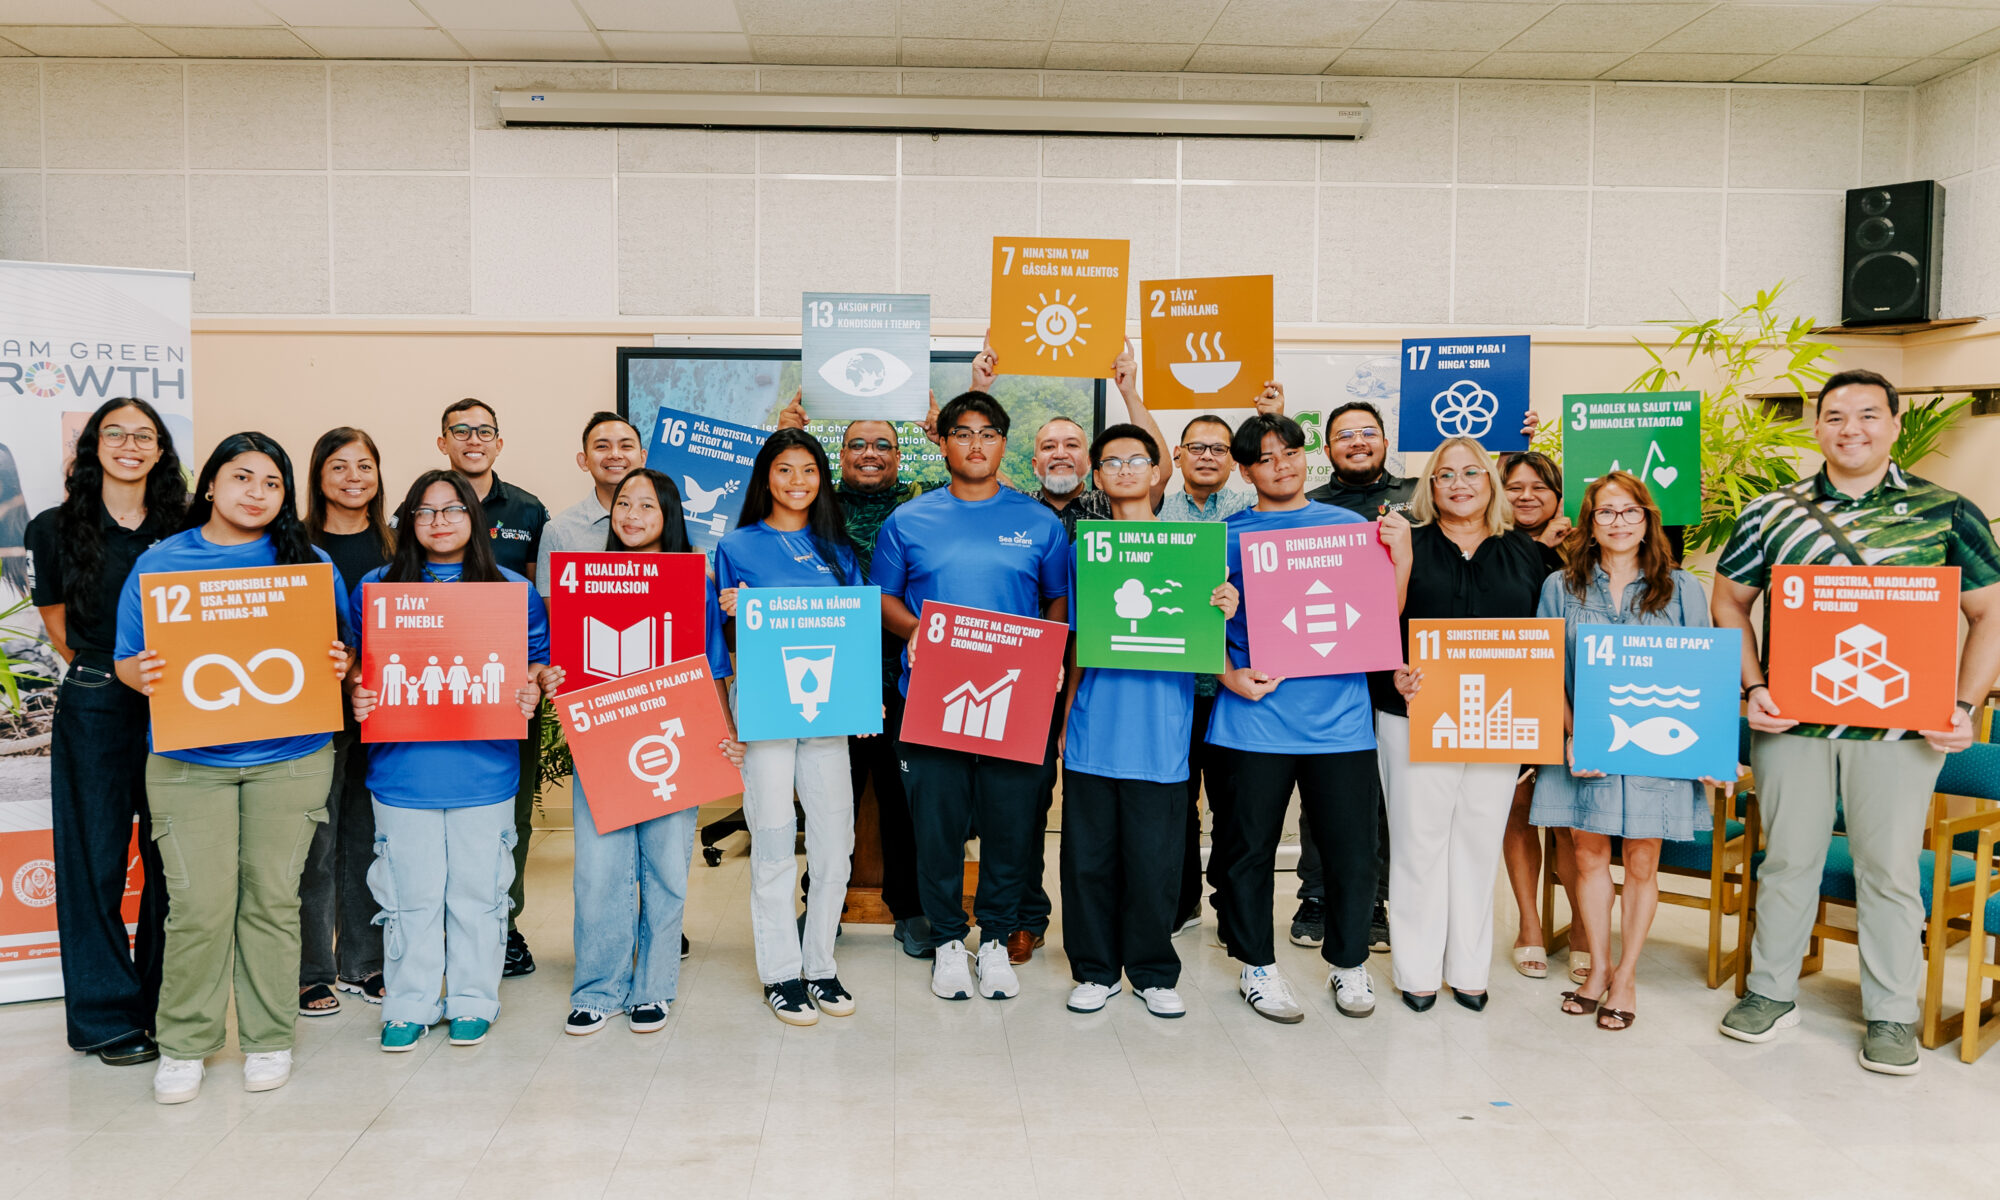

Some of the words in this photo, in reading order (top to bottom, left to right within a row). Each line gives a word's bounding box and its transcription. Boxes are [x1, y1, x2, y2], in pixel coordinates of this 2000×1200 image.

[1002, 247, 1015, 275] 7
[1023, 248, 1068, 259] NINA'SINA
[1071, 249, 1089, 259] YAN
[1022, 262, 1058, 275] GÅSGÅS
[1061, 266, 1073, 276] NA
[1076, 267, 1119, 277] ALIENTOS
[1170, 288, 1197, 301] TÅYA'
[838, 303, 868, 312] AKSION
[871, 304, 886, 312] PUT
[889, 304, 892, 312] I
[1150, 290, 1165, 317] 2
[1171, 303, 1218, 316] NIÑALANG
[808, 301, 834, 328] 13
[838, 319, 882, 328] KONDISION
[885, 320, 888, 328] I
[891, 320, 920, 328] TIEMPO
[4, 340, 50, 357] AM
[71, 342, 183, 362] GREEN
[1439, 345, 1474, 354] INETNON
[1477, 345, 1499, 354] PARA
[1502, 344, 1505, 353] I
[1407, 346, 1431, 370] 17
[1438, 360, 1467, 369] HINGA'
[1470, 360, 1490, 368] SIHA
[0, 362, 184, 399] ROWTH
[1590, 404, 1625, 414] MAOLEK
[1628, 403, 1640, 413] NA
[1643, 402, 1671, 412] SALUT
[1673, 401, 1691, 411] YAN
[1571, 403, 1587, 431] 3
[1590, 419, 1634, 429] MINAOLEK
[1637, 417, 1683, 427] TATAOTAO
[661, 418, 687, 447] 16
[712, 426, 753, 444] HUSTISTIA,
[755, 436, 768, 446] YA
[897, 436, 926, 444] ation
[691, 433, 721, 447] METGOT
[722, 440, 733, 450] NA
[688, 444, 734, 462] INSTITUTION
[736, 455, 754, 467] SIHA
[1317, 466, 1331, 475] OF
[1083, 531, 1112, 562] 15
[1119, 532, 1154, 544] LINA'LA
[1157, 533, 1168, 544] GI
[1171, 533, 1196, 545] HILO'
[1285, 535, 1346, 552] RINIBAHAN
[1349, 534, 1354, 546] I
[1356, 533, 1367, 545] TI
[1119, 551, 1123, 562] I
[1125, 552, 1153, 563] TANO'
[1248, 541, 1278, 573] 10
[1287, 554, 1343, 570] PINAREHU
[585, 560, 640, 576] KUALIDÅT
[643, 564, 659, 577] NA
[200, 578, 271, 593] RESPONSIBLE
[274, 577, 288, 588] NA
[291, 575, 307, 587] MA
[560, 562, 579, 593] 4
[1814, 576, 1872, 588] INDUSTRIA,
[1874, 577, 1937, 588] INADILANTO
[585, 581, 649, 594] EDUKASION
[1783, 576, 1804, 609] 9
[1814, 588, 1834, 599] YAN
[1836, 590, 1884, 600] KINAHATI
[1887, 590, 1940, 602] FASILIDAT
[150, 585, 191, 623] 12
[201, 594, 243, 607] USA-NA
[244, 592, 266, 604] YAN
[268, 591, 285, 602] MA
[395, 594, 429, 610] TÅYA'
[769, 597, 808, 611] GÅSGÅS
[811, 598, 824, 610] NA
[826, 596, 861, 609] HÅNOM
[1813, 602, 1858, 612] PUBLIKU
[202, 606, 268, 621] FA'TINAS-NA
[374, 597, 386, 629] 1
[746, 599, 763, 630] 6
[395, 616, 444, 628] PINEBLE
[770, 618, 788, 629] YAN
[791, 618, 795, 628] I
[797, 616, 846, 628] GINASGAS
[927, 613, 947, 643] 8
[954, 615, 989, 629] DESENTE
[990, 621, 1001, 632] NA
[953, 626, 969, 637] YAN
[970, 629, 983, 640] MA
[985, 632, 1017, 646] HATSAN
[1018, 638, 1023, 647] I
[1446, 630, 1499, 640] SINISTIENE
[1502, 630, 1516, 640] NA
[1518, 629, 1550, 640] SIUDA
[950, 638, 993, 653] EKONOMIA
[1416, 630, 1440, 660] 11
[1583, 635, 1616, 666] 14
[1622, 636, 1663, 648] LINA'LA
[1665, 637, 1677, 649] GI
[1680, 638, 1713, 650] PAPA'
[1446, 648, 1466, 659] YAN
[1469, 648, 1528, 659] KOMUNIDAT
[1530, 648, 1555, 659] SIHA
[1622, 655, 1626, 666] I
[1629, 656, 1653, 667] TASI
[588, 699, 594, 710] I
[594, 683, 648, 708] CHINILONG
[649, 681, 655, 692] I
[655, 668, 704, 690] PALAO'AN
[568, 701, 591, 733] 5
[593, 711, 617, 726] LAHI
[617, 706, 639, 718] YAN
[640, 696, 667, 712] OTRO
